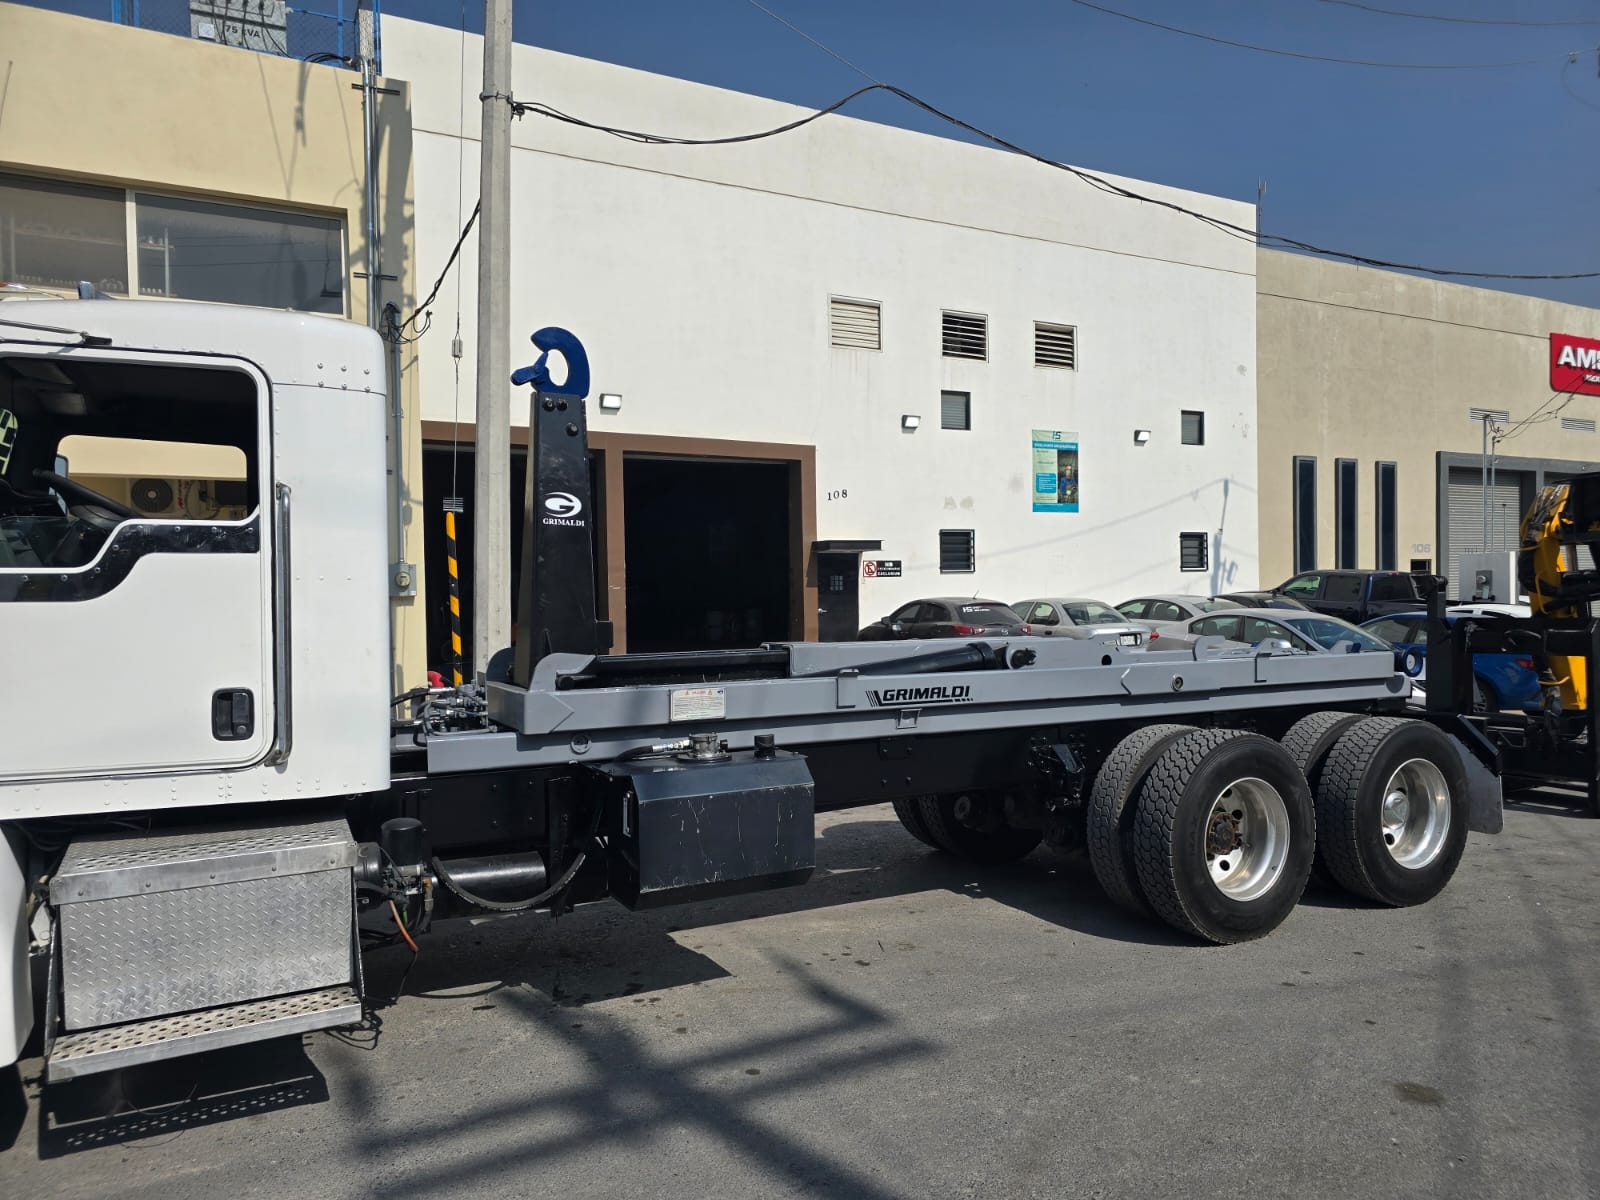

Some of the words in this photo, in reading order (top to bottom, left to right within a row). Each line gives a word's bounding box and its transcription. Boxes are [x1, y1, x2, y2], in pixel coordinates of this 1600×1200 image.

[225, 25, 238, 34] 75
[827, 489, 848, 501] 108
[542, 517, 585, 527] GRIMALDI
[882, 685, 970, 701] GRIMALDI
